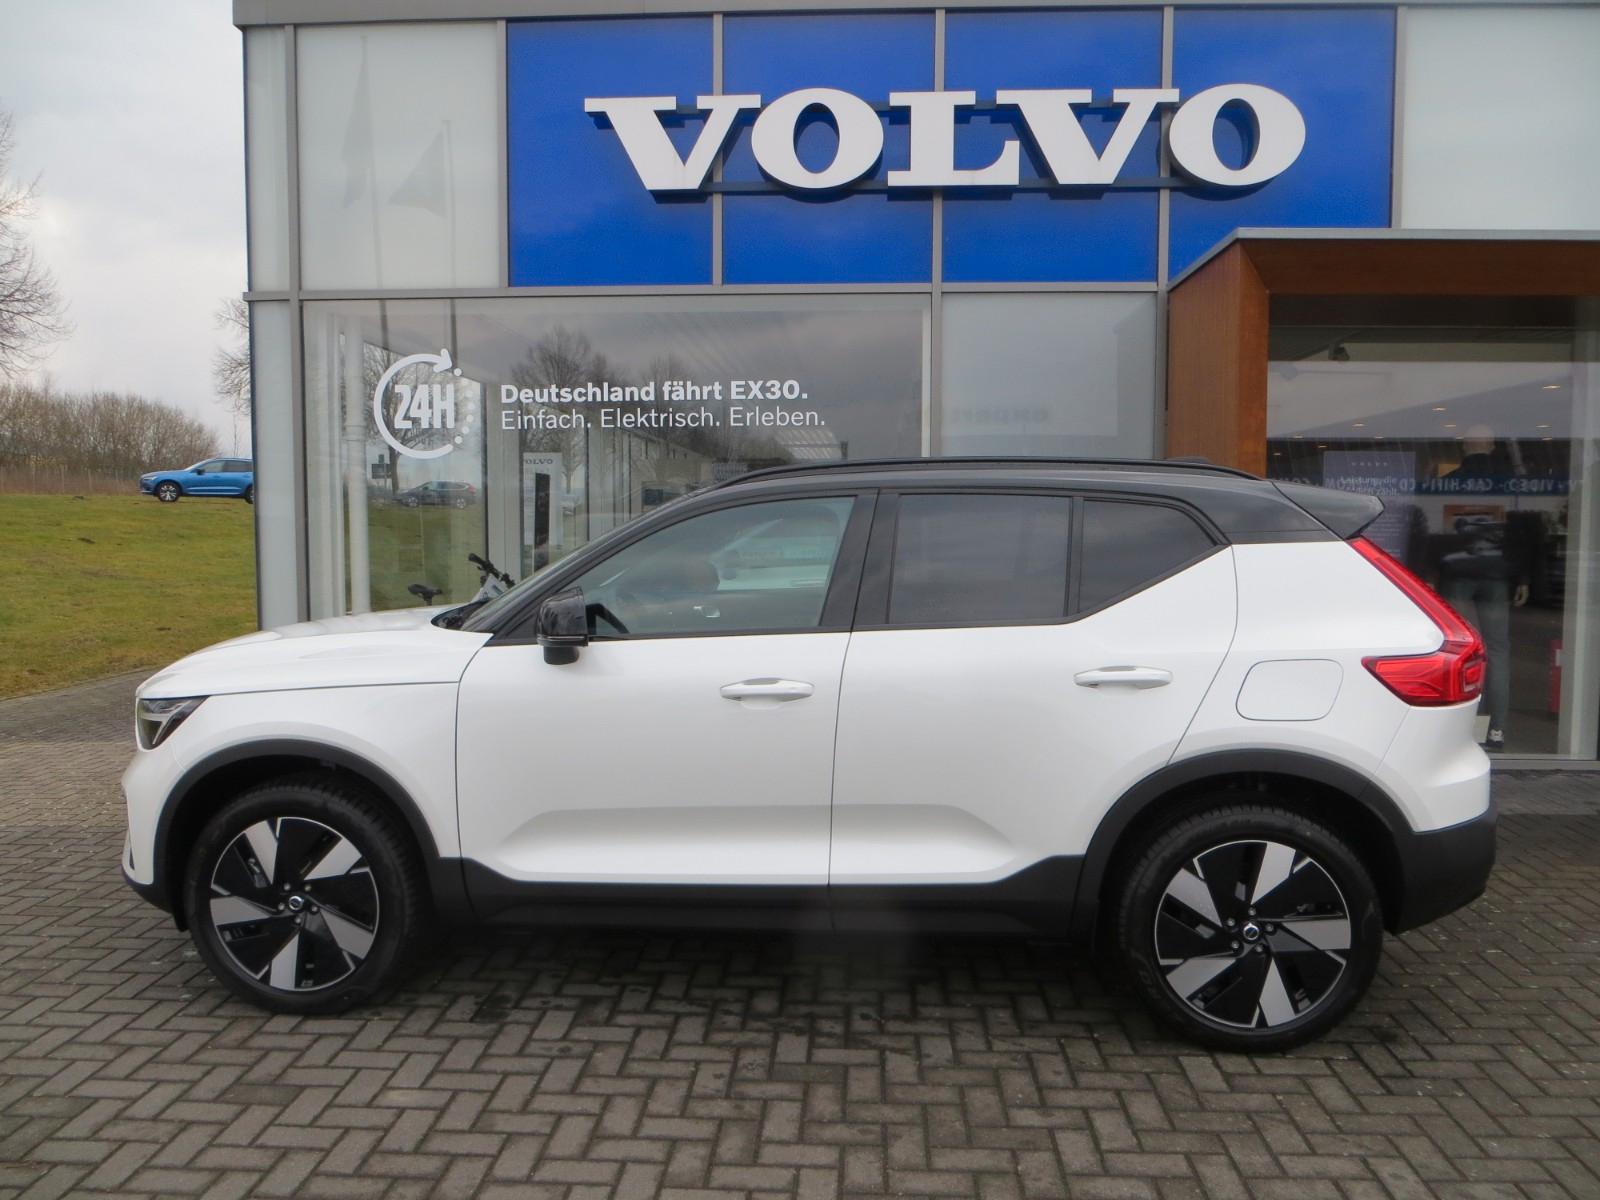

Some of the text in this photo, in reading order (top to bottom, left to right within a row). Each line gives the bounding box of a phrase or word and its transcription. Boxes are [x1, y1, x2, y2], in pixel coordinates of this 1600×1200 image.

[584, 83, 1306, 190] VOLVO
[394, 383, 455, 429] 24H
[501, 380, 808, 403] Deutschland fährt EX30.
[501, 406, 825, 430] Einfach. Elektrisch. Erleben.
